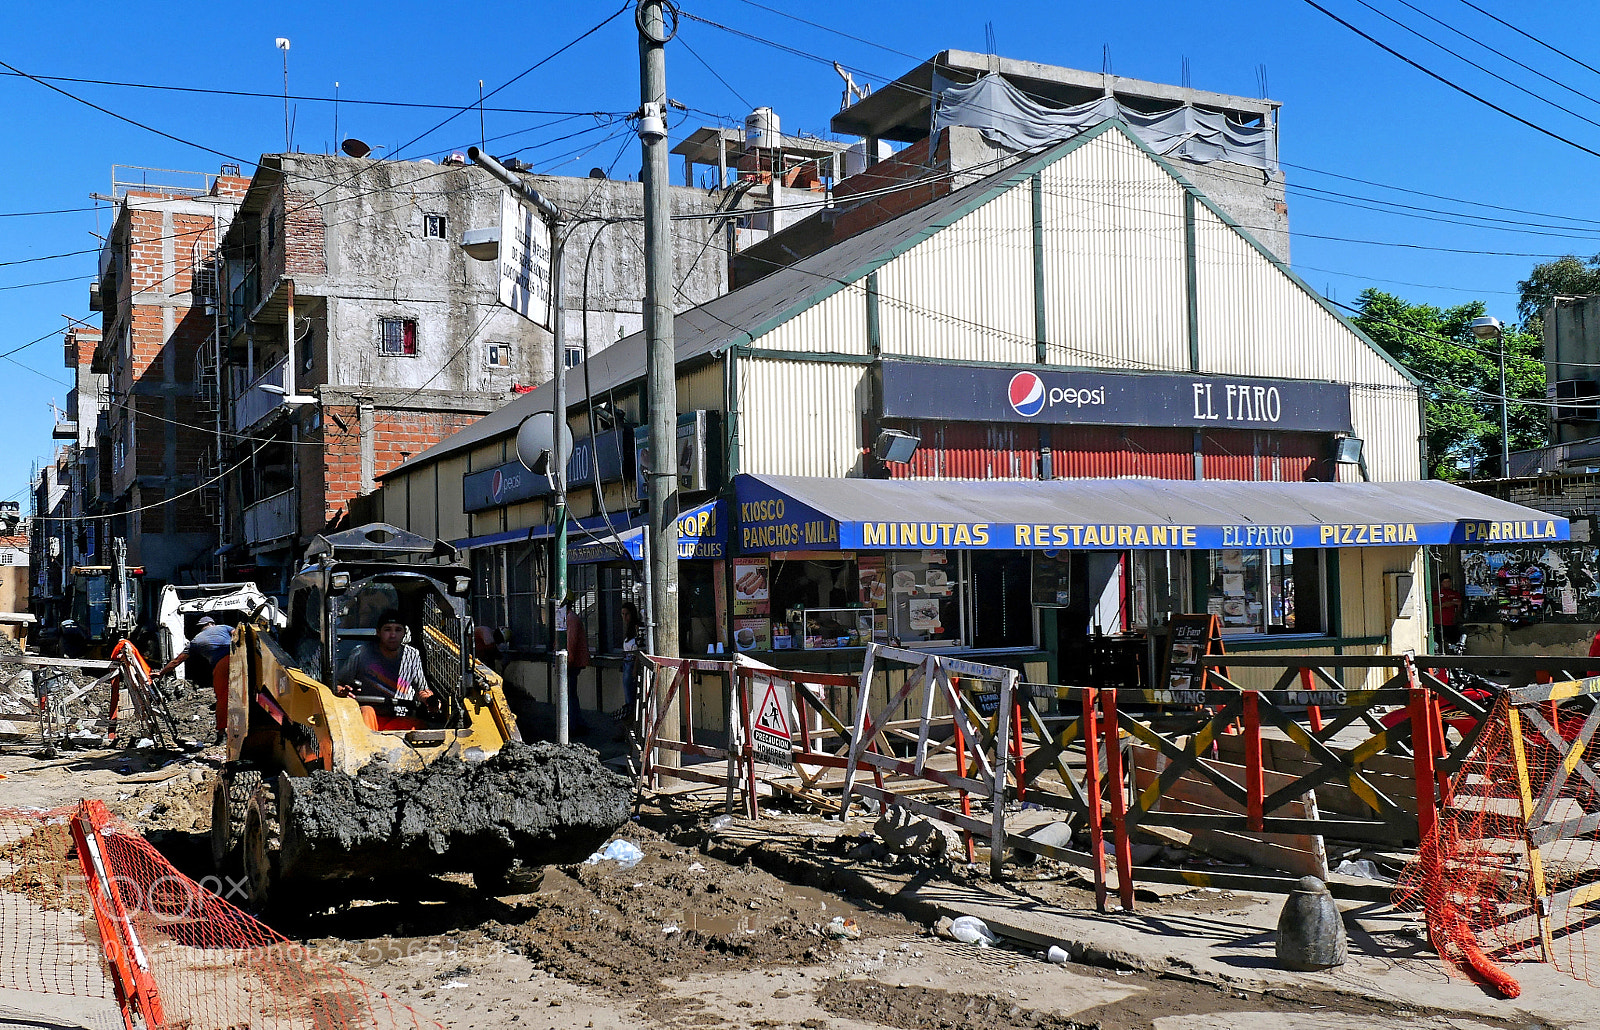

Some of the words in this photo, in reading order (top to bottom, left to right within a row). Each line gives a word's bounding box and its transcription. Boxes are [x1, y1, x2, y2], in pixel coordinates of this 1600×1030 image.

[1049, 385, 1105, 407] pepsi
[1192, 383, 1219, 420] EL
[1226, 383, 1282, 422] FARO
[568, 445, 588, 482] ARO
[503, 471, 521, 491] pepsi
[740, 499, 785, 523] KIOSCO
[863, 522, 990, 547] MINUTAS
[1015, 524, 1197, 547] RESTAURANTE
[1222, 526, 1244, 547] EL
[1245, 525, 1294, 546] FARO
[1320, 523, 1418, 544] PIZZERIA
[1465, 520, 1557, 541] PARRILLA
[1153, 690, 1206, 704] ROWING
[1288, 691, 1347, 704] ROWING
[755, 730, 789, 750] PRECAUCION
[757, 743, 786, 760] HOMBRES
